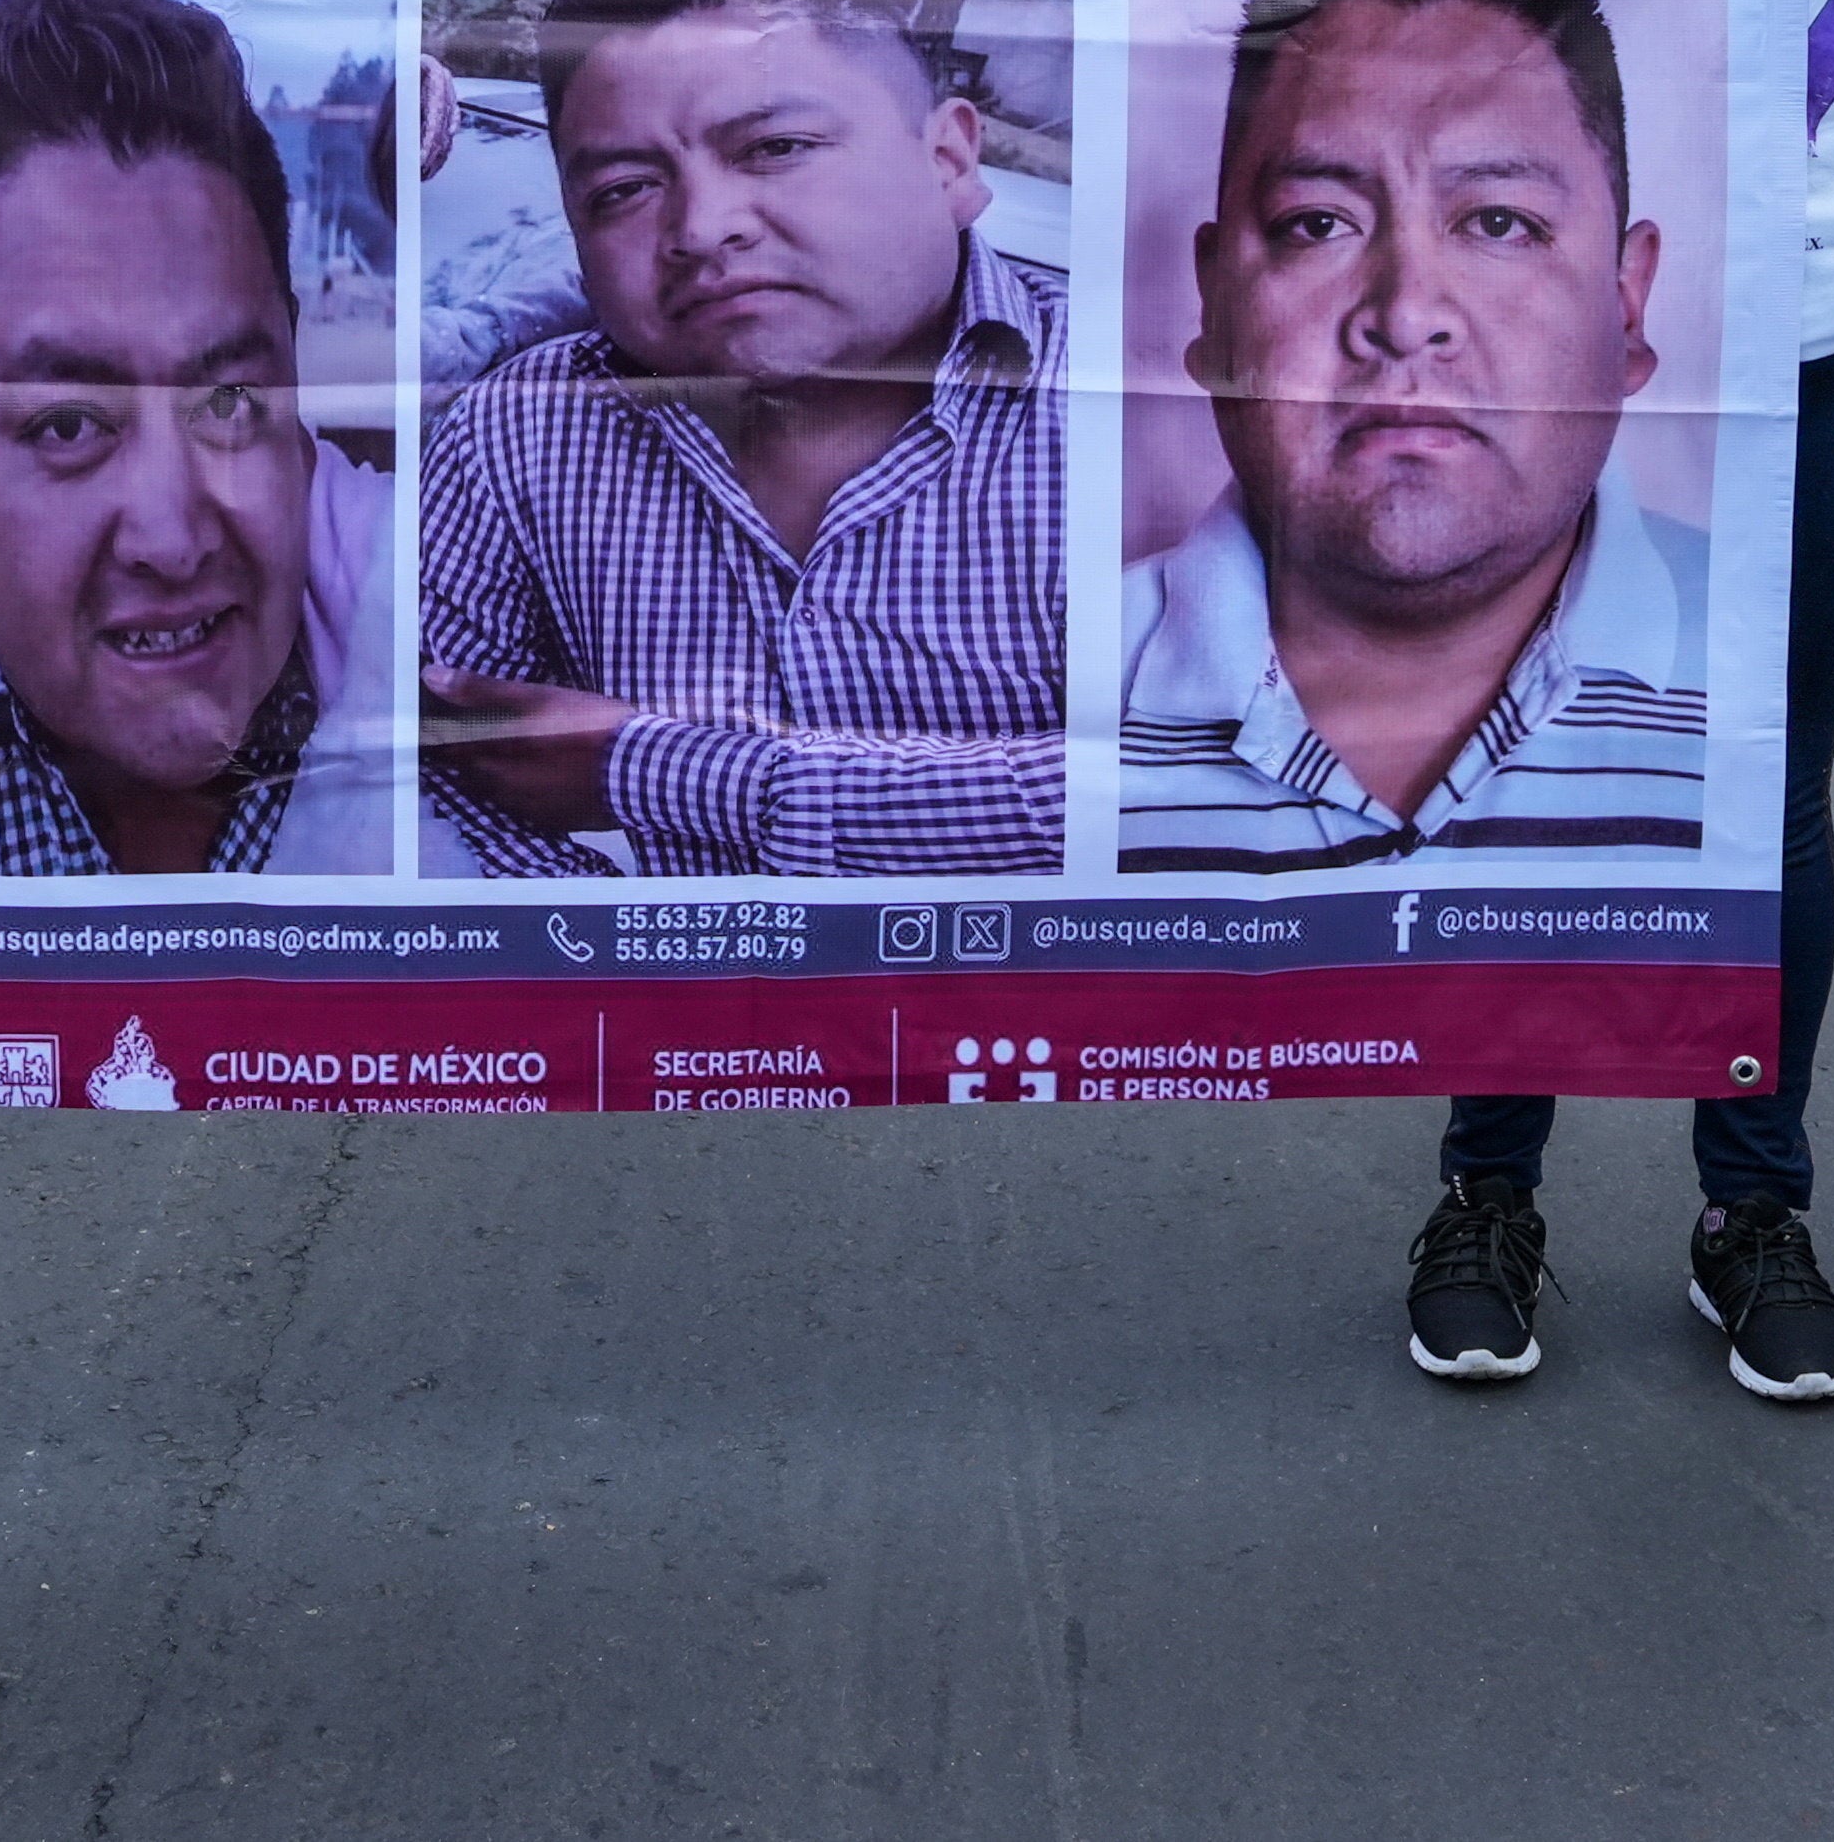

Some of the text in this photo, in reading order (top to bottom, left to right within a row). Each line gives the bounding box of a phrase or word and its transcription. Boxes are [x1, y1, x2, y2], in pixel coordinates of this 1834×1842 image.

[615, 902, 807, 932] 55.63.57.92.82
[1033, 915, 1301, 946] @busqueda_cdmx
[1436, 905, 1711, 938] @cbusquedacdmx
[615, 934, 807, 962] 55.63.57.80.79
